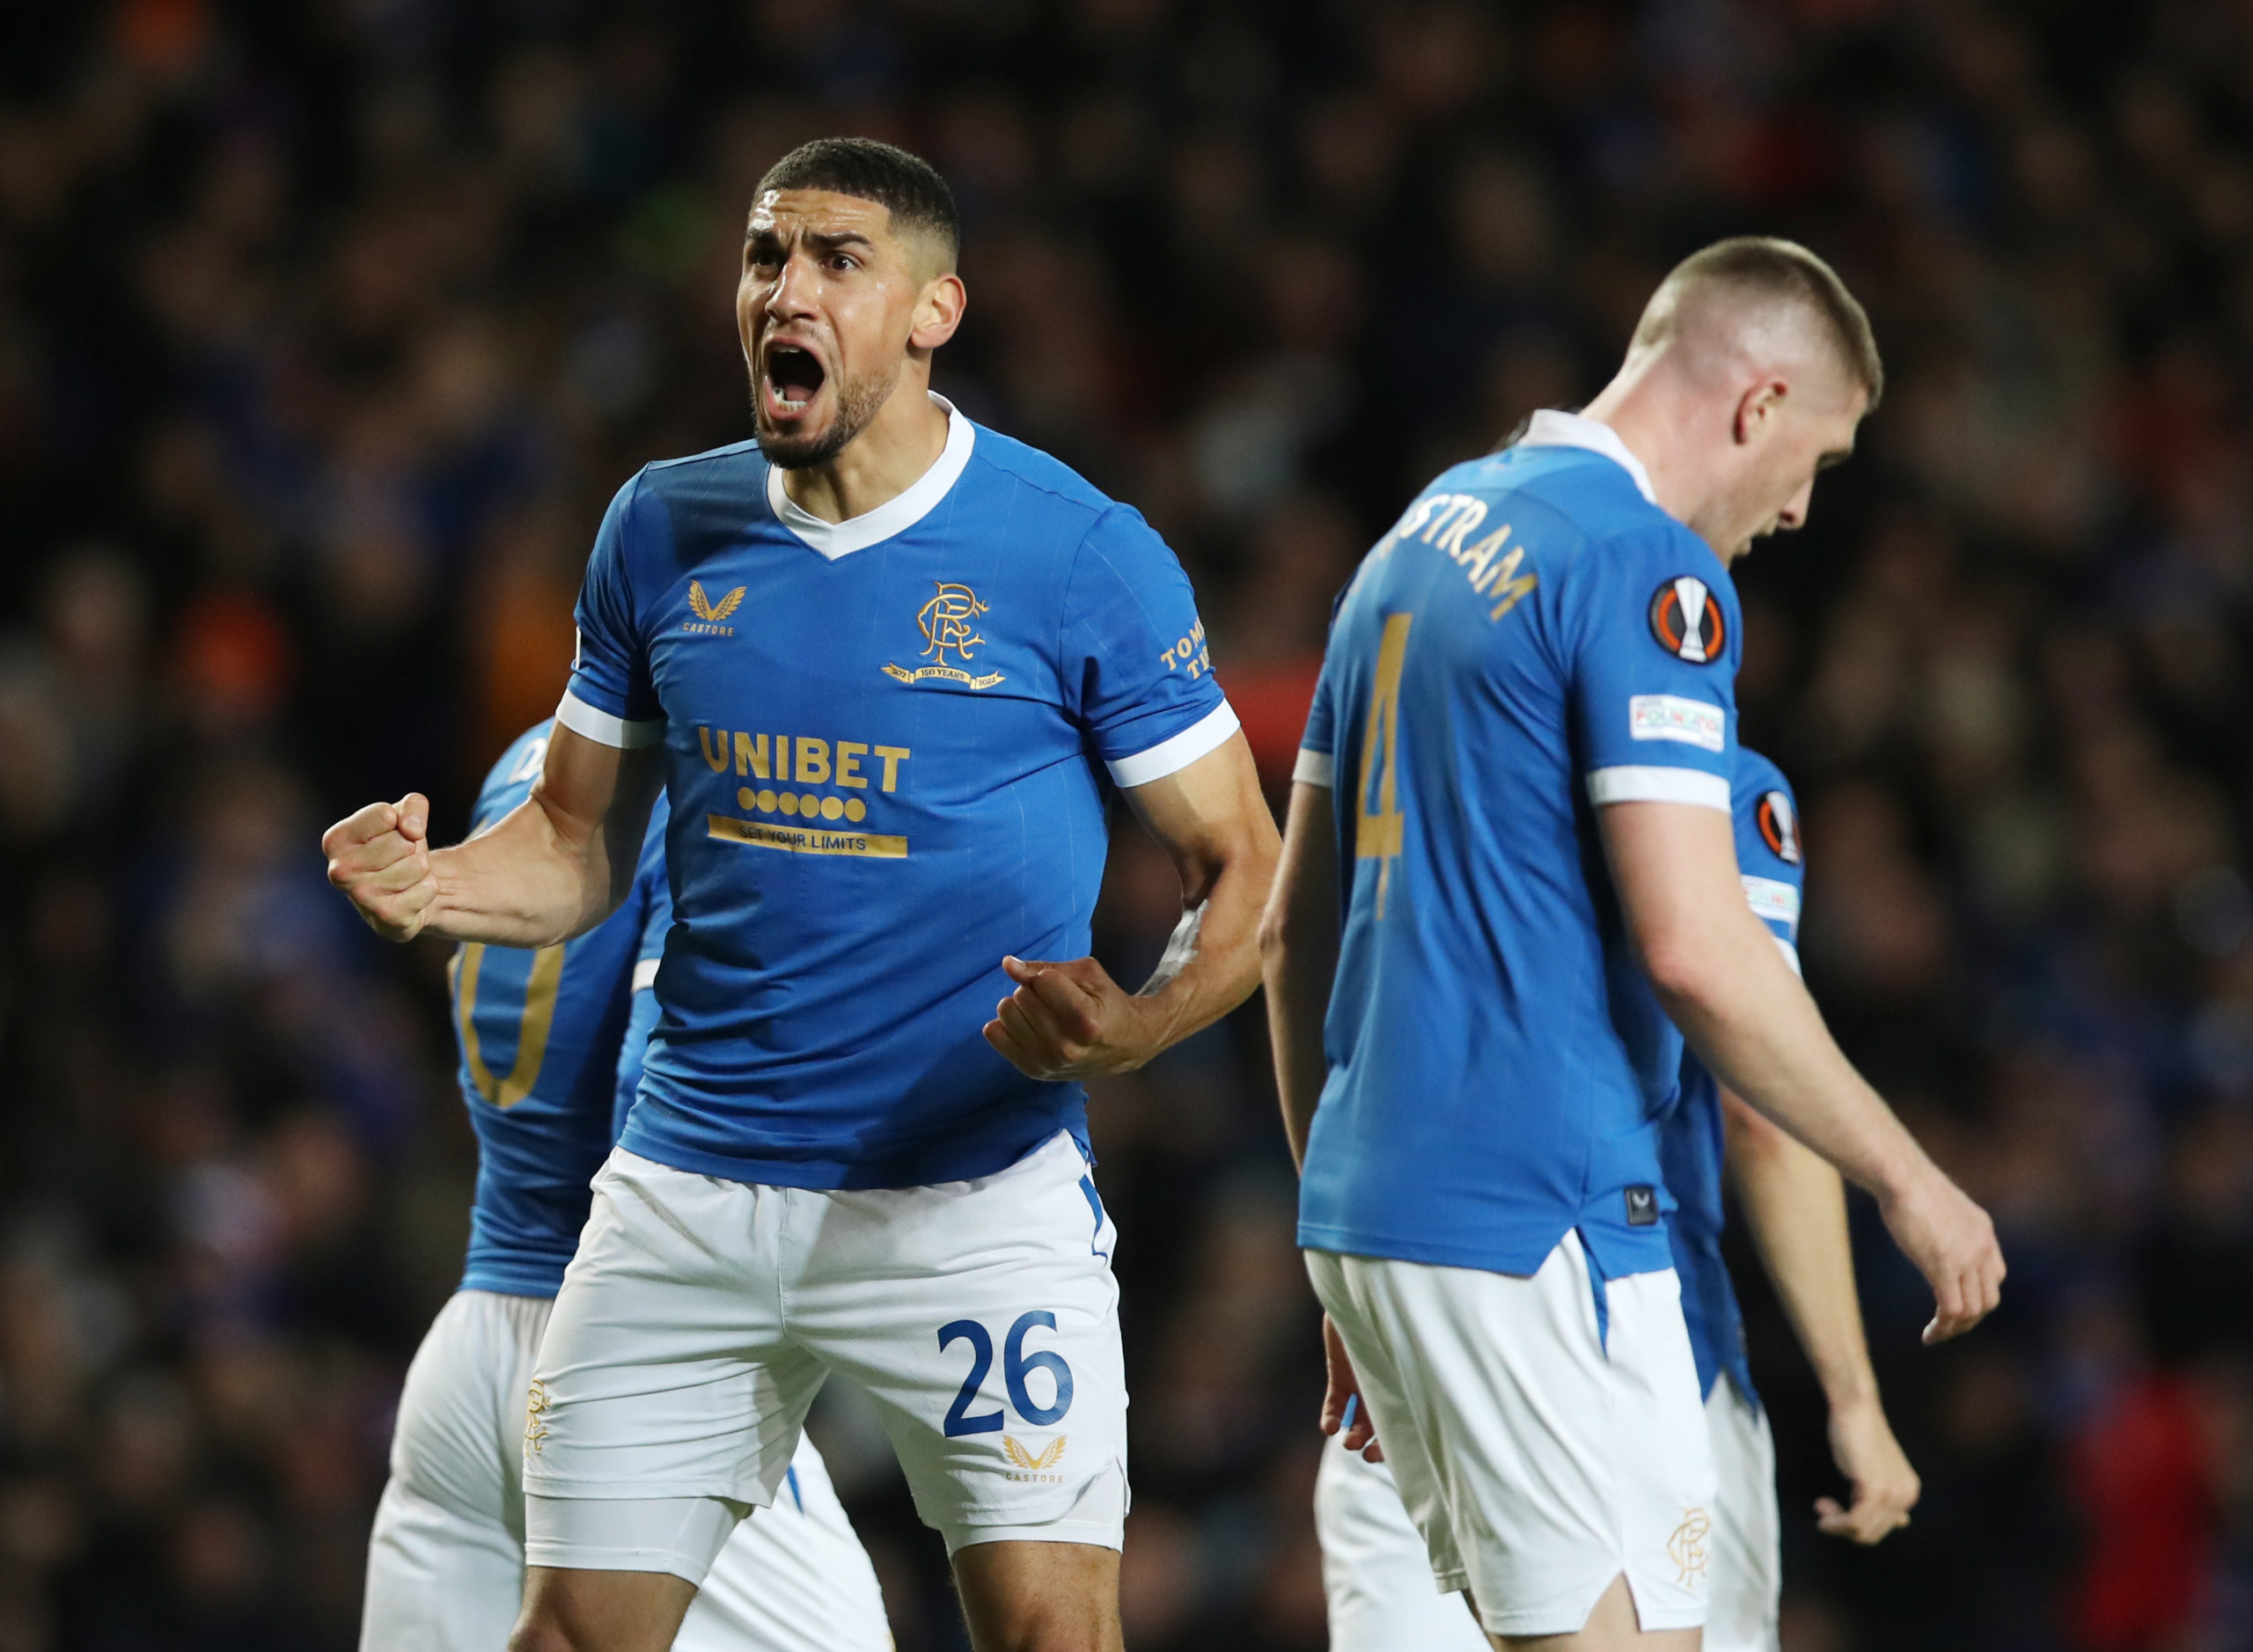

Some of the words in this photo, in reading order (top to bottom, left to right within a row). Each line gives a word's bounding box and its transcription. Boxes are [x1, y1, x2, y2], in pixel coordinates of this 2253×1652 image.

[1339, 493, 1537, 621] STRAM
[683, 622, 734, 636] CASTORE
[937, 669, 965, 679] YEARS
[699, 726, 910, 793] UNIBET
[1355, 613, 1413, 920] 4
[739, 826, 763, 840] SET
[767, 830, 805, 847] YOUR
[811, 835, 866, 850] LIMITS
[937, 1310, 1074, 1438] 26
[1006, 1472, 1064, 1484] CASTORE
